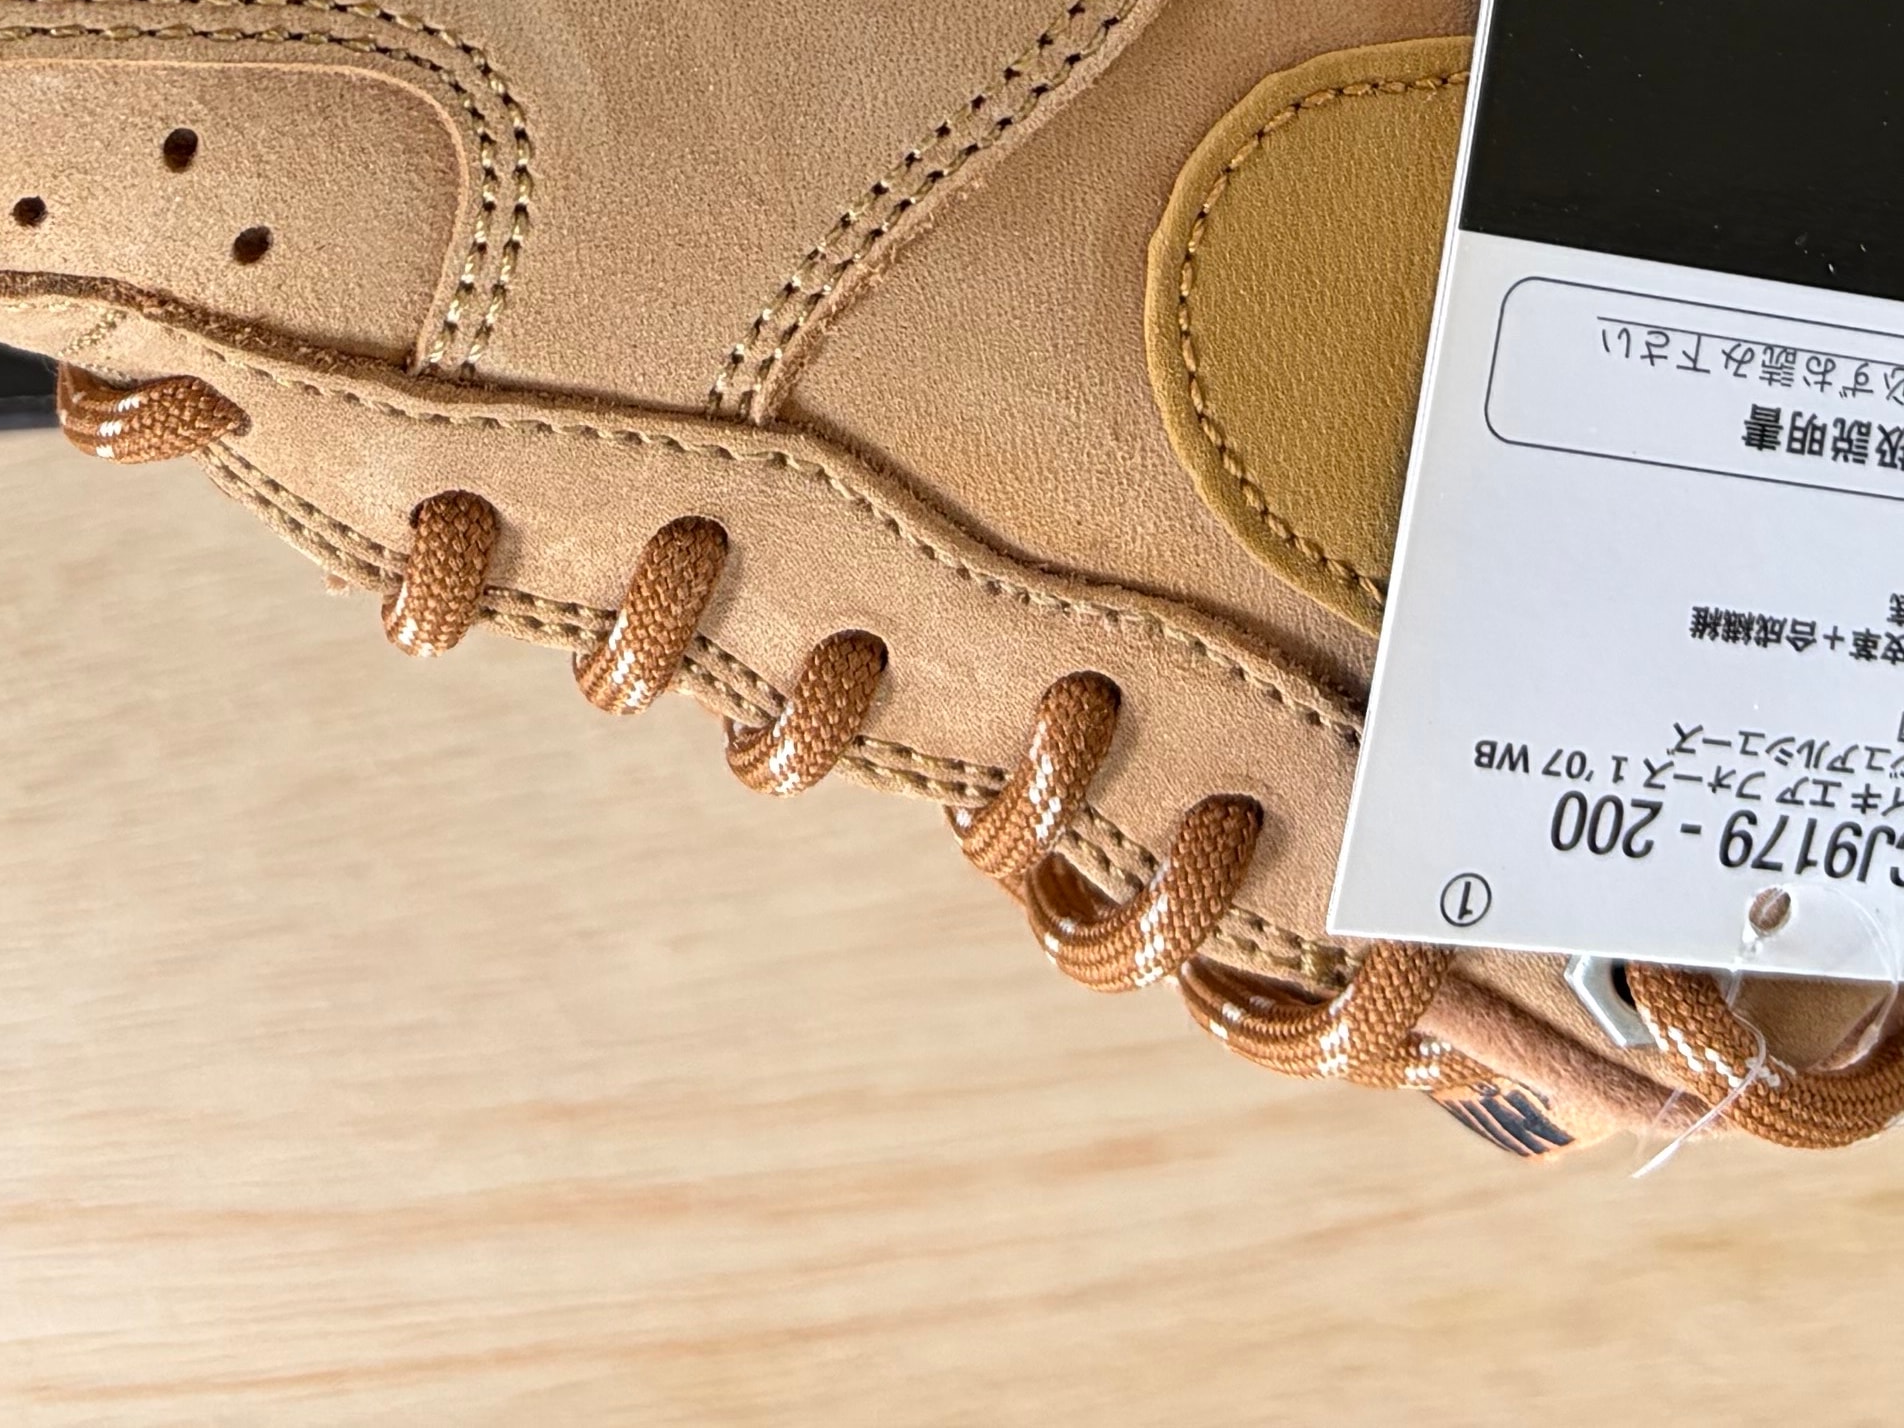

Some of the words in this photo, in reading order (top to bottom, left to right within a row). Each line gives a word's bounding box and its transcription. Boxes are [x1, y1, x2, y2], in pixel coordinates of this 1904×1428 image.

[1474, 739, 1530, 774] WB
[1611, 755, 1629, 784] 1
[1549, 789, 1665, 859] 200
